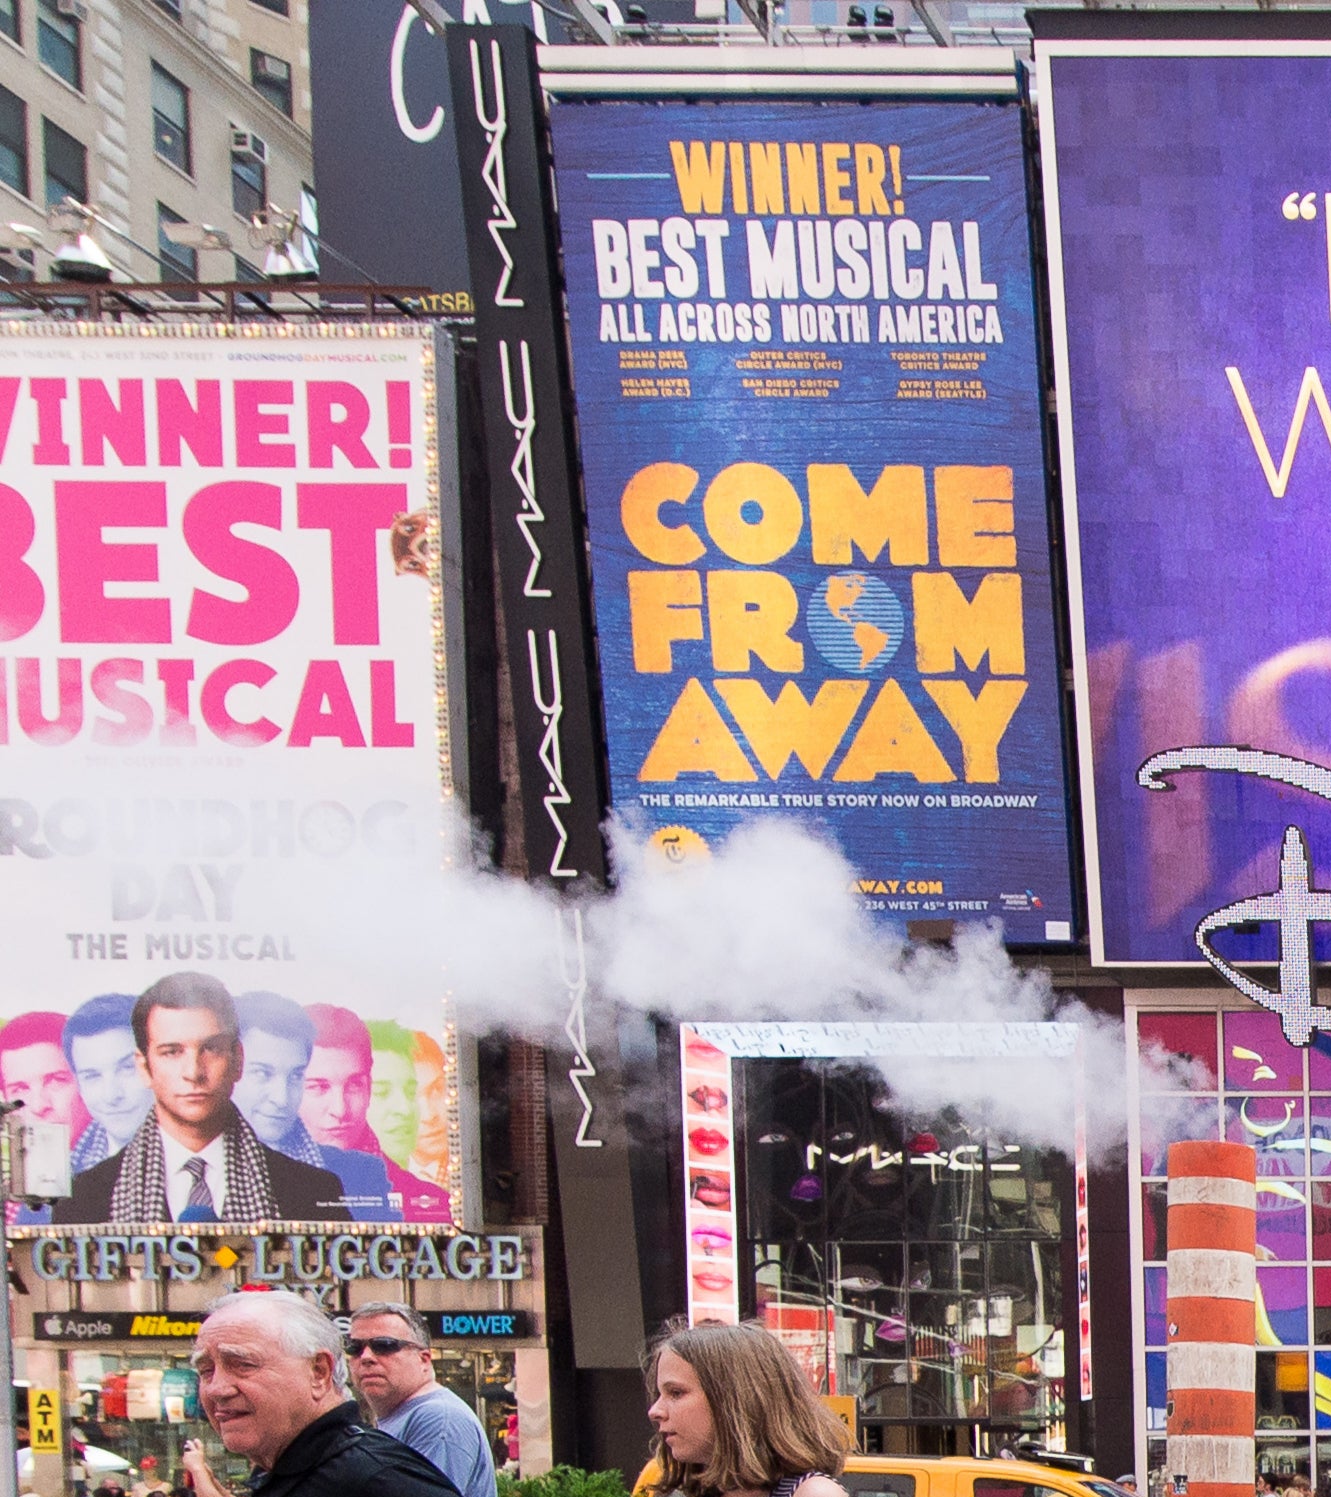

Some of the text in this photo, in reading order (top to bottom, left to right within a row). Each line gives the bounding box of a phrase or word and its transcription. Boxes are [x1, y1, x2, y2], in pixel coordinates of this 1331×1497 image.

[669, 141, 905, 216] WINNER!
[592, 217, 997, 300] BEST MUSICAL
[600, 303, 1003, 343] ALL ACROSS NORTH AMERICA
[227, 354, 408, 363] GROUNDHOGDAYMUSICAL.COM
[620, 351, 656, 360] DRAMA
[750, 352, 826, 361] OUTER CRITICS
[891, 352, 987, 361] TORONTO THEATRE
[620, 361, 688, 370] AWARD (NYC)
[735, 361, 843, 371] CIRCLE AWARD (NYC)
[900, 362, 980, 371] CRITICS AWARD
[621, 378, 655, 387] HELEN
[766, 379, 798, 388] DIEGO
[800, 379, 840, 388] CRITICS
[899, 381, 932, 390] GYPSY
[963, 381, 983, 389] LEE
[622, 388, 660, 397] AWARD
[754, 389, 829, 398] CIRCLE AWARD
[897, 390, 987, 399] AWARD (SEATTLE)
[621, 462, 1016, 567] COME
[627, 569, 1026, 676] FROM
[0, 657, 415, 749] USICAL
[638, 677, 1029, 784] AWAY
[640, 793, 1038, 808] THE REMARKABLE TRUE STORY NOW ON BROADWAY
[0, 797, 417, 860] ROUNDHOG
[111, 863, 246, 922] DAY
[850, 881, 943, 894] AWAY.COM
[865, 901, 886, 911] 236
[887, 901, 920, 911] WEST
[947, 901, 989, 911] STREET
[66, 933, 296, 961] THE MUSICAL
[31, 1235, 524, 1281] GIFTS LUGGAGE
[66, 1318, 113, 1337] Apple
[130, 1316, 199, 1337] Nikon
[441, 1314, 514, 1335] BOWER
[37, 1392, 55, 1443] ATM
